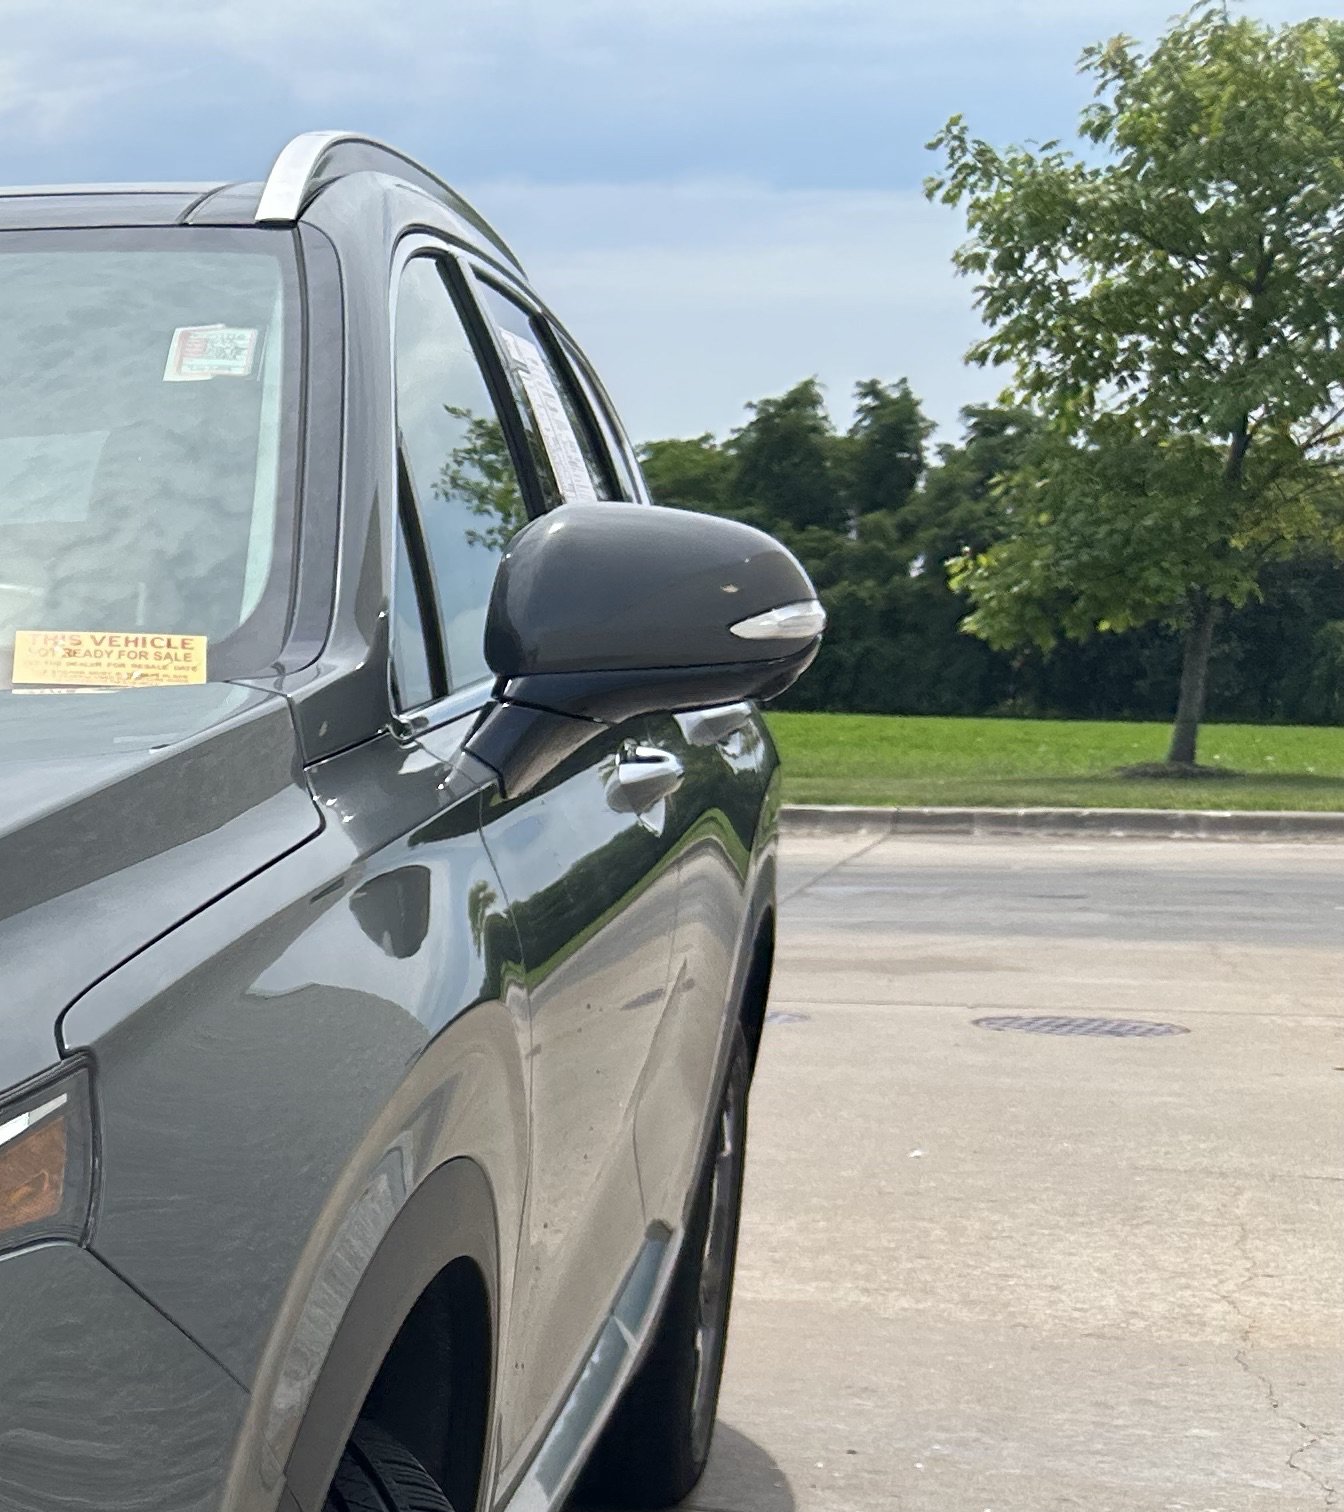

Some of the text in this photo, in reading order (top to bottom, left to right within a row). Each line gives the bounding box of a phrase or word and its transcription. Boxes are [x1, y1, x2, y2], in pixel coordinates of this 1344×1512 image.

[90, 634, 194, 650] VEHICLE
[62, 648, 113, 658] READY
[118, 650, 149, 660] FOR
[154, 651, 193, 662] SALE
